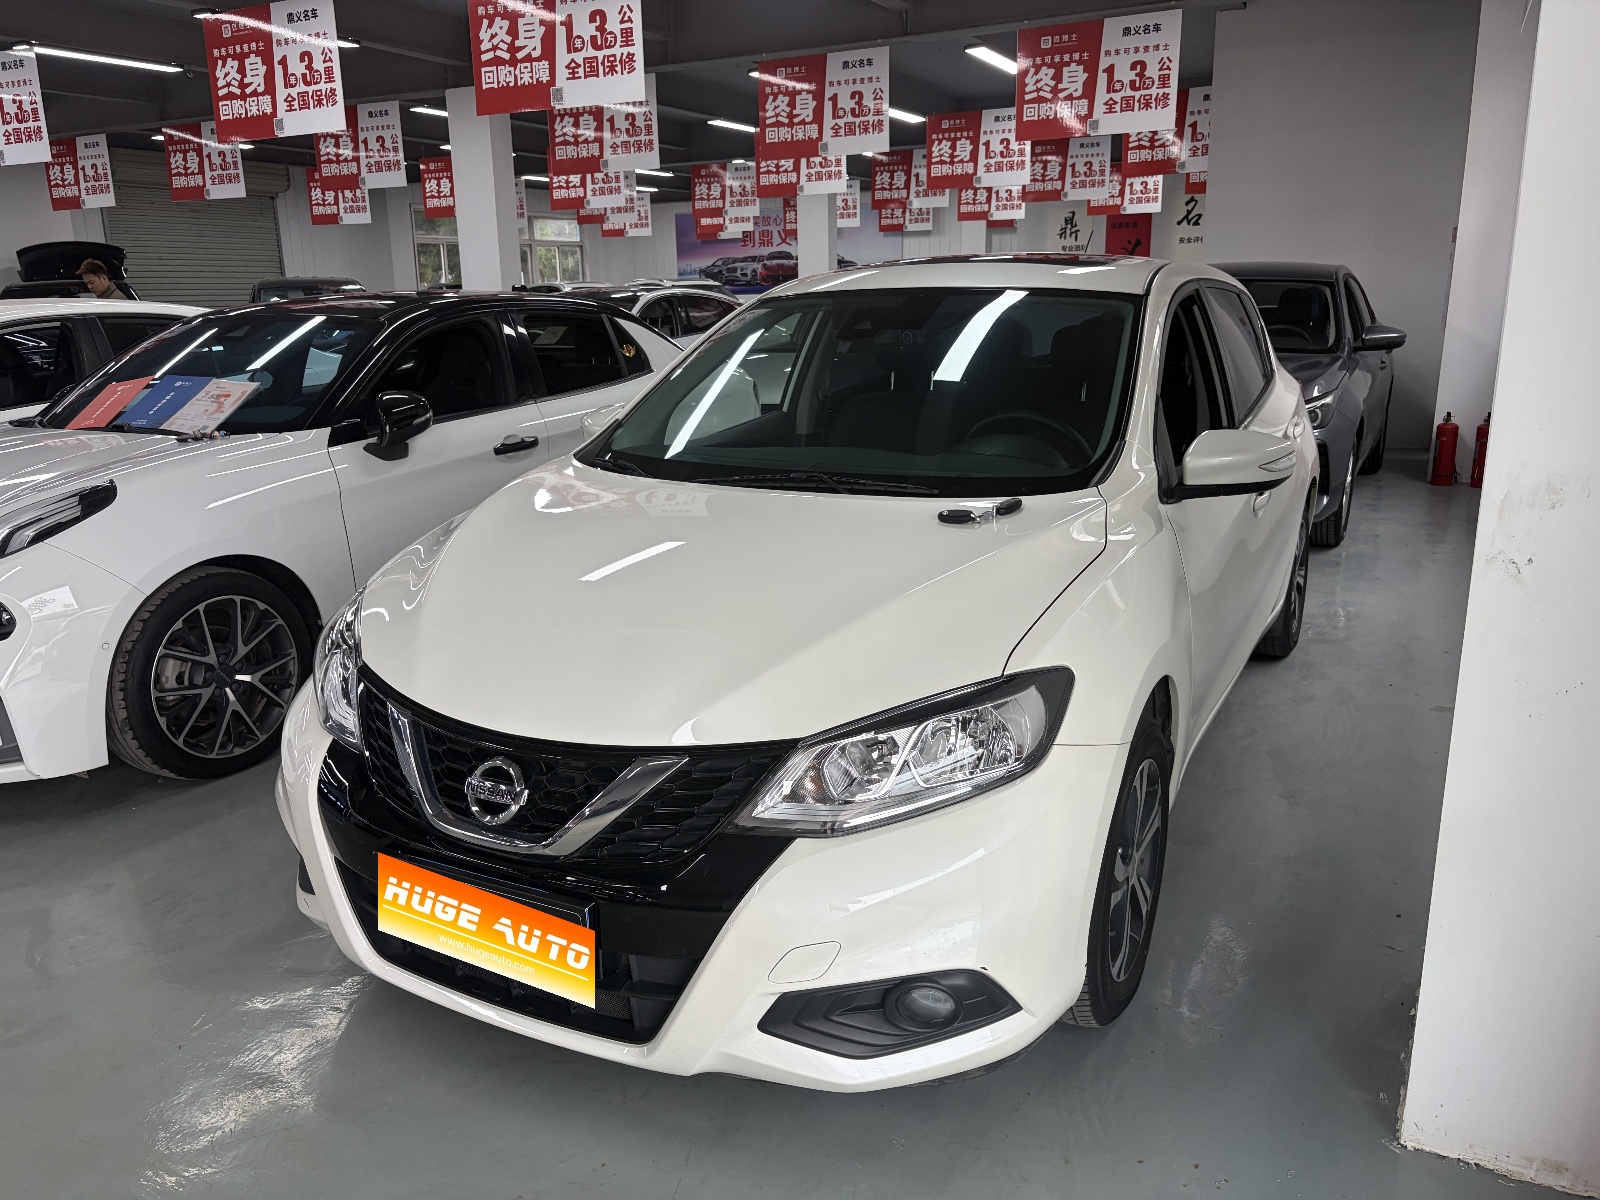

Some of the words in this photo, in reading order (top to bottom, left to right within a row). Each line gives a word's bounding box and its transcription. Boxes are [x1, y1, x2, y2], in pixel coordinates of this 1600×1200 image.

[286, 8, 319, 24] 鼎义名车
[479, 15, 546, 62] 终身
[1122, 23, 1162, 37] 鼎义名车
[1104, 43, 1171, 57] 购车可享查博士
[565, 51, 637, 81] 全国保修
[842, 58, 874, 70] 鼎义名车
[215, 53, 268, 97] 终身
[481, 60, 550, 90] 回购保障
[1024, 63, 1089, 101] 终身
[218, 95, 273, 121] 回购保障
[283, 87, 338, 113] 全国保修
[765, 92, 818, 124] 终身
[1103, 92, 1171, 115] 全国保修
[1023, 99, 1089, 122] 回购保障
[3, 126, 44, 146] 全国保修
[554, 113, 598, 142] 终身
[765, 124, 820, 144] 回购保障
[830, 119, 885, 138] 全国保修
[319, 134, 354, 161] 终身
[555, 142, 600, 160] 回购保障
[609, 138, 655, 155] 全国保修
[931, 138, 974, 162] 终身
[170, 150, 200, 175] 终身
[1128, 148, 1178, 163] 回购保障
[49, 163, 76, 185] 终身
[321, 161, 358, 177] 回购保障
[365, 159, 402, 174] 全国保修
[931, 162, 975, 177] 回购保障
[983, 159, 1027, 173] 全国保修
[1030, 161, 1062, 180] 终身
[172, 174, 204, 188] 回购保障
[209, 172, 241, 186] 全国保修
[760, 172, 797, 185] 回购保障
[805, 169, 842, 182] 全国保修
[875, 171, 907, 189] 终身
[1070, 178, 1106, 189] 全国保修
[84, 183, 111, 195] 全国保修
[425, 178, 452, 197] 终身
[553, 187, 584, 199] 回购保障
[591, 185, 622, 197] 全国保修
[695, 183, 722, 199] 终身
[875, 189, 907, 200] 回购保障
[1026, 180, 1063, 192] 回购保障
[311, 187, 335, 205] 终身
[426, 197, 455, 208] 回购保障
[729, 199, 757, 208] 全国保修
[961, 188, 988, 203] 终身
[1128, 195, 1159, 205] 全国保修
[343, 204, 368, 214] 全国保修
[995, 203, 1022, 211] 全国保修
[1176, 195, 1203, 226] 名
[1057, 210, 1080, 242] 鼎
[466, 779, 517, 804] NISSAN
